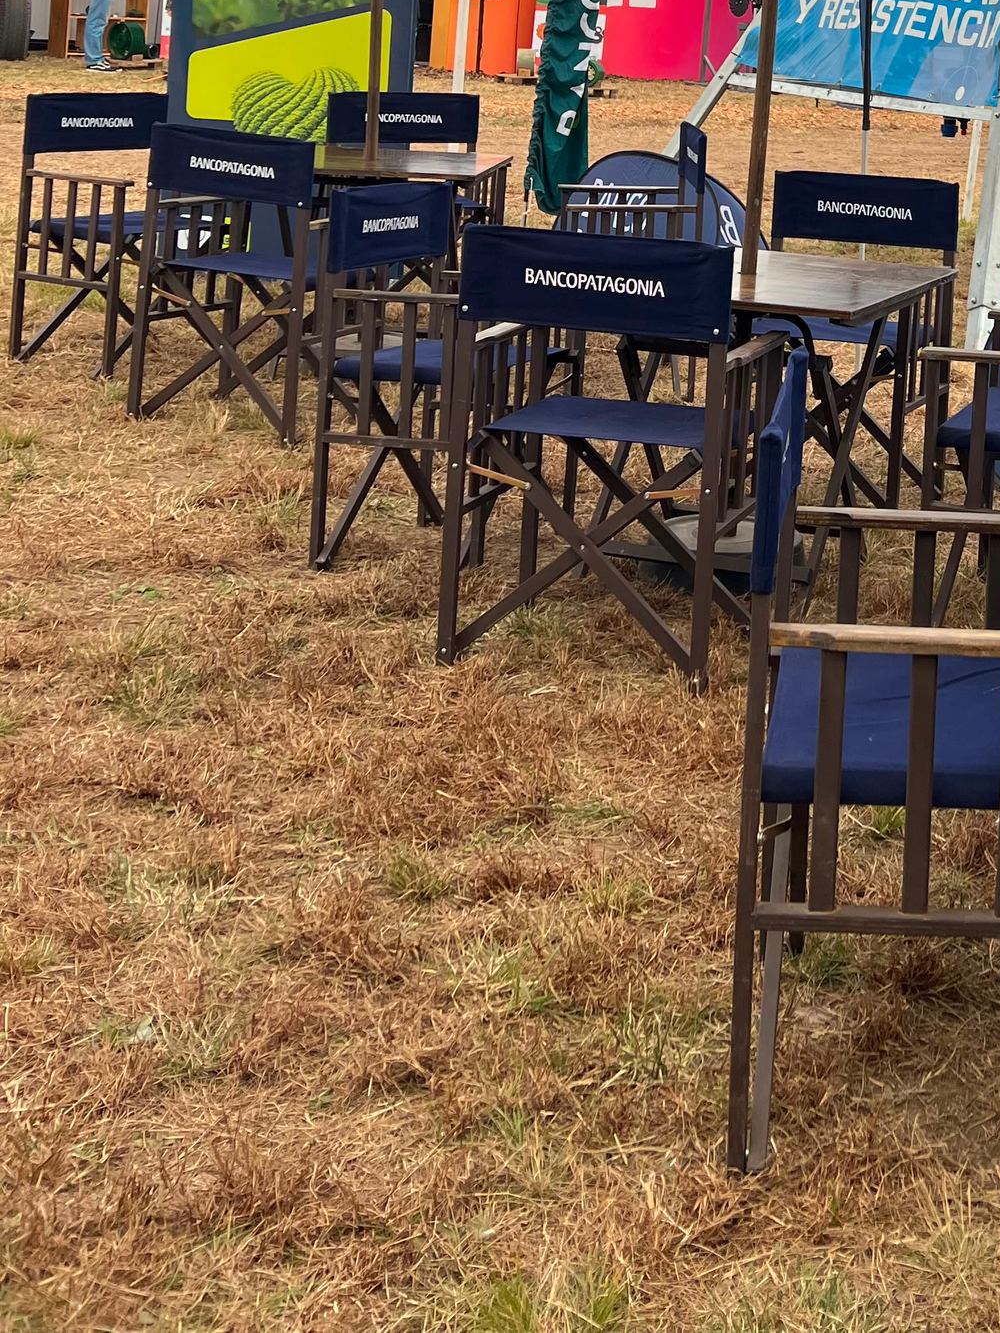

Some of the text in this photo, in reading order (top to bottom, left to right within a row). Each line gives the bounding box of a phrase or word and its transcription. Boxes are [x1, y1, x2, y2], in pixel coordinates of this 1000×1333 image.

[61, 116, 134, 128] BANCOPATAGONIA
[364, 112, 443, 124] NCOPATAGONIA
[189, 155, 275, 179] BANCOPATAGONIA
[816, 199, 912, 221] BANCOPATAGONIA
[362, 215, 419, 234] BANCOPATAGONIA
[525, 267, 665, 298] BANCOPATAGONIA
